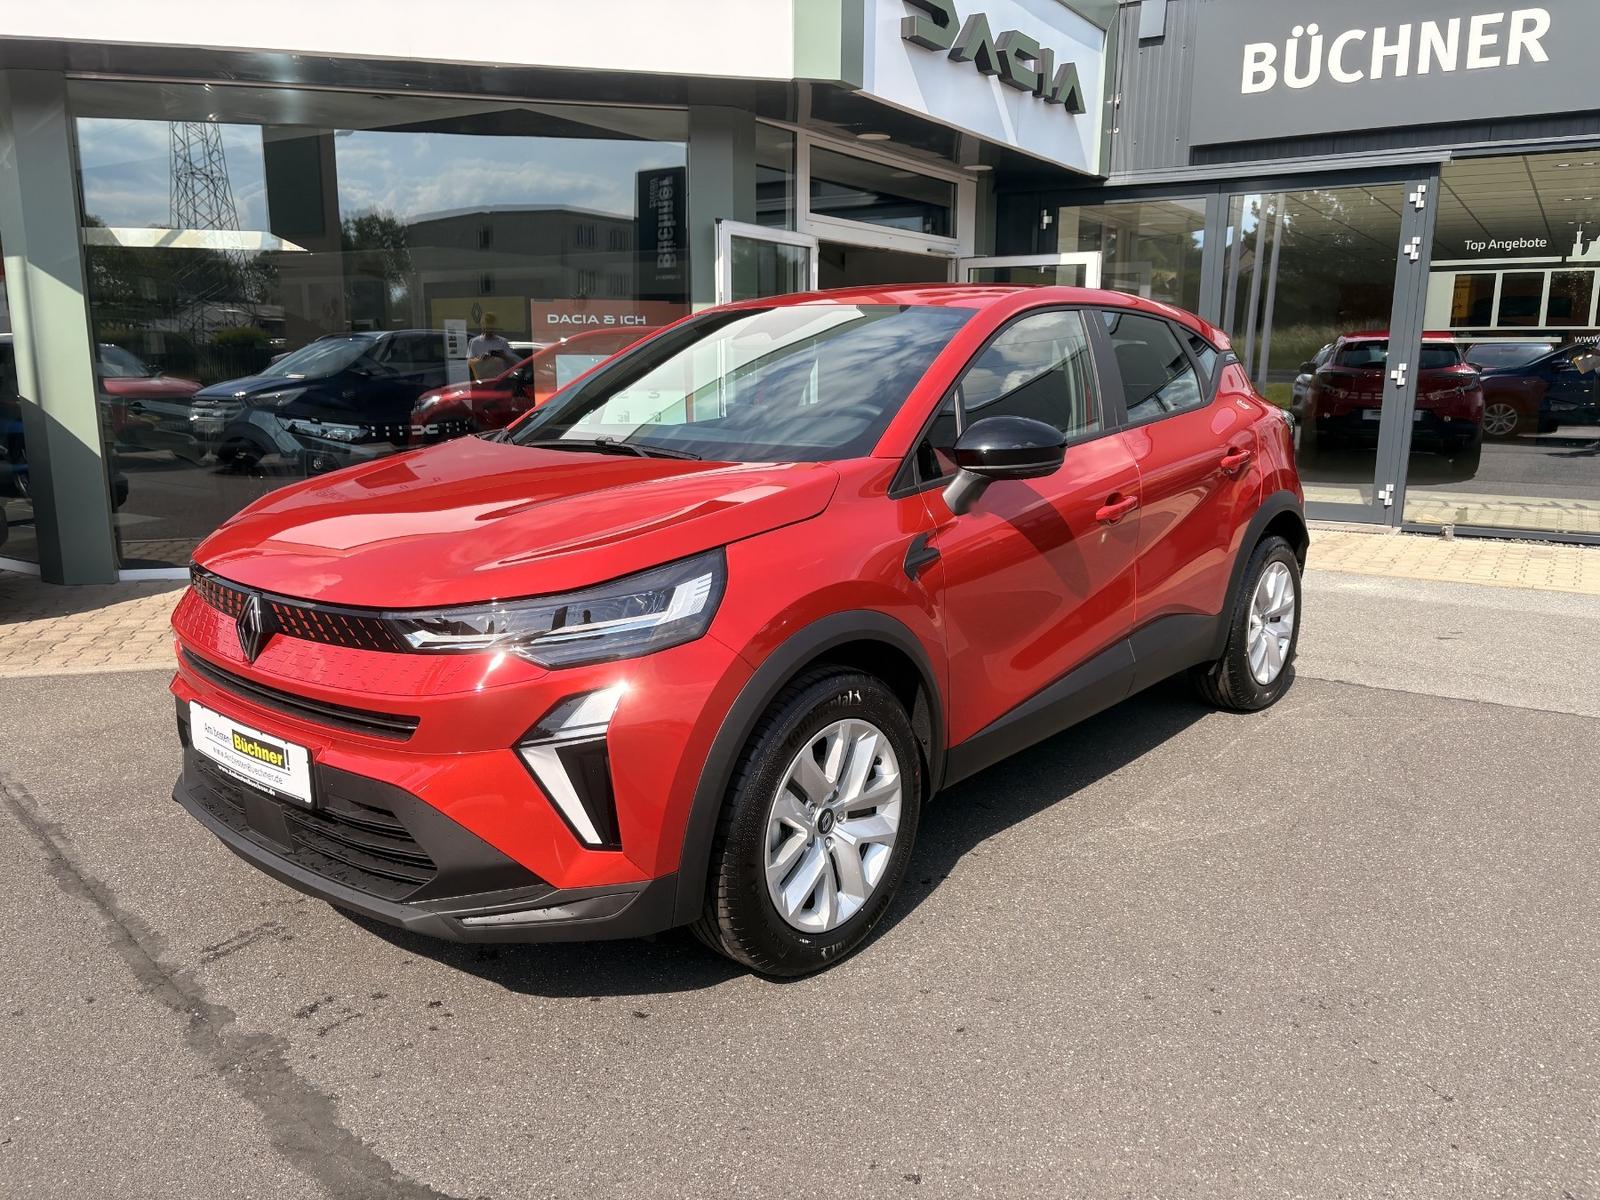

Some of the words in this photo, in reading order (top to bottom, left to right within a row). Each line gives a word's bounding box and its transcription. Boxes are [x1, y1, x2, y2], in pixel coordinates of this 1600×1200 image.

[901, 0, 1086, 115] DACIA
[1241, 7, 1551, 94] BÜCHNER
[1464, 240, 1486, 252] Top
[1488, 237, 1547, 251] Angebote
[547, 314, 599, 324] DACIA
[603, 315, 615, 324] &
[620, 315, 646, 325] ICH
